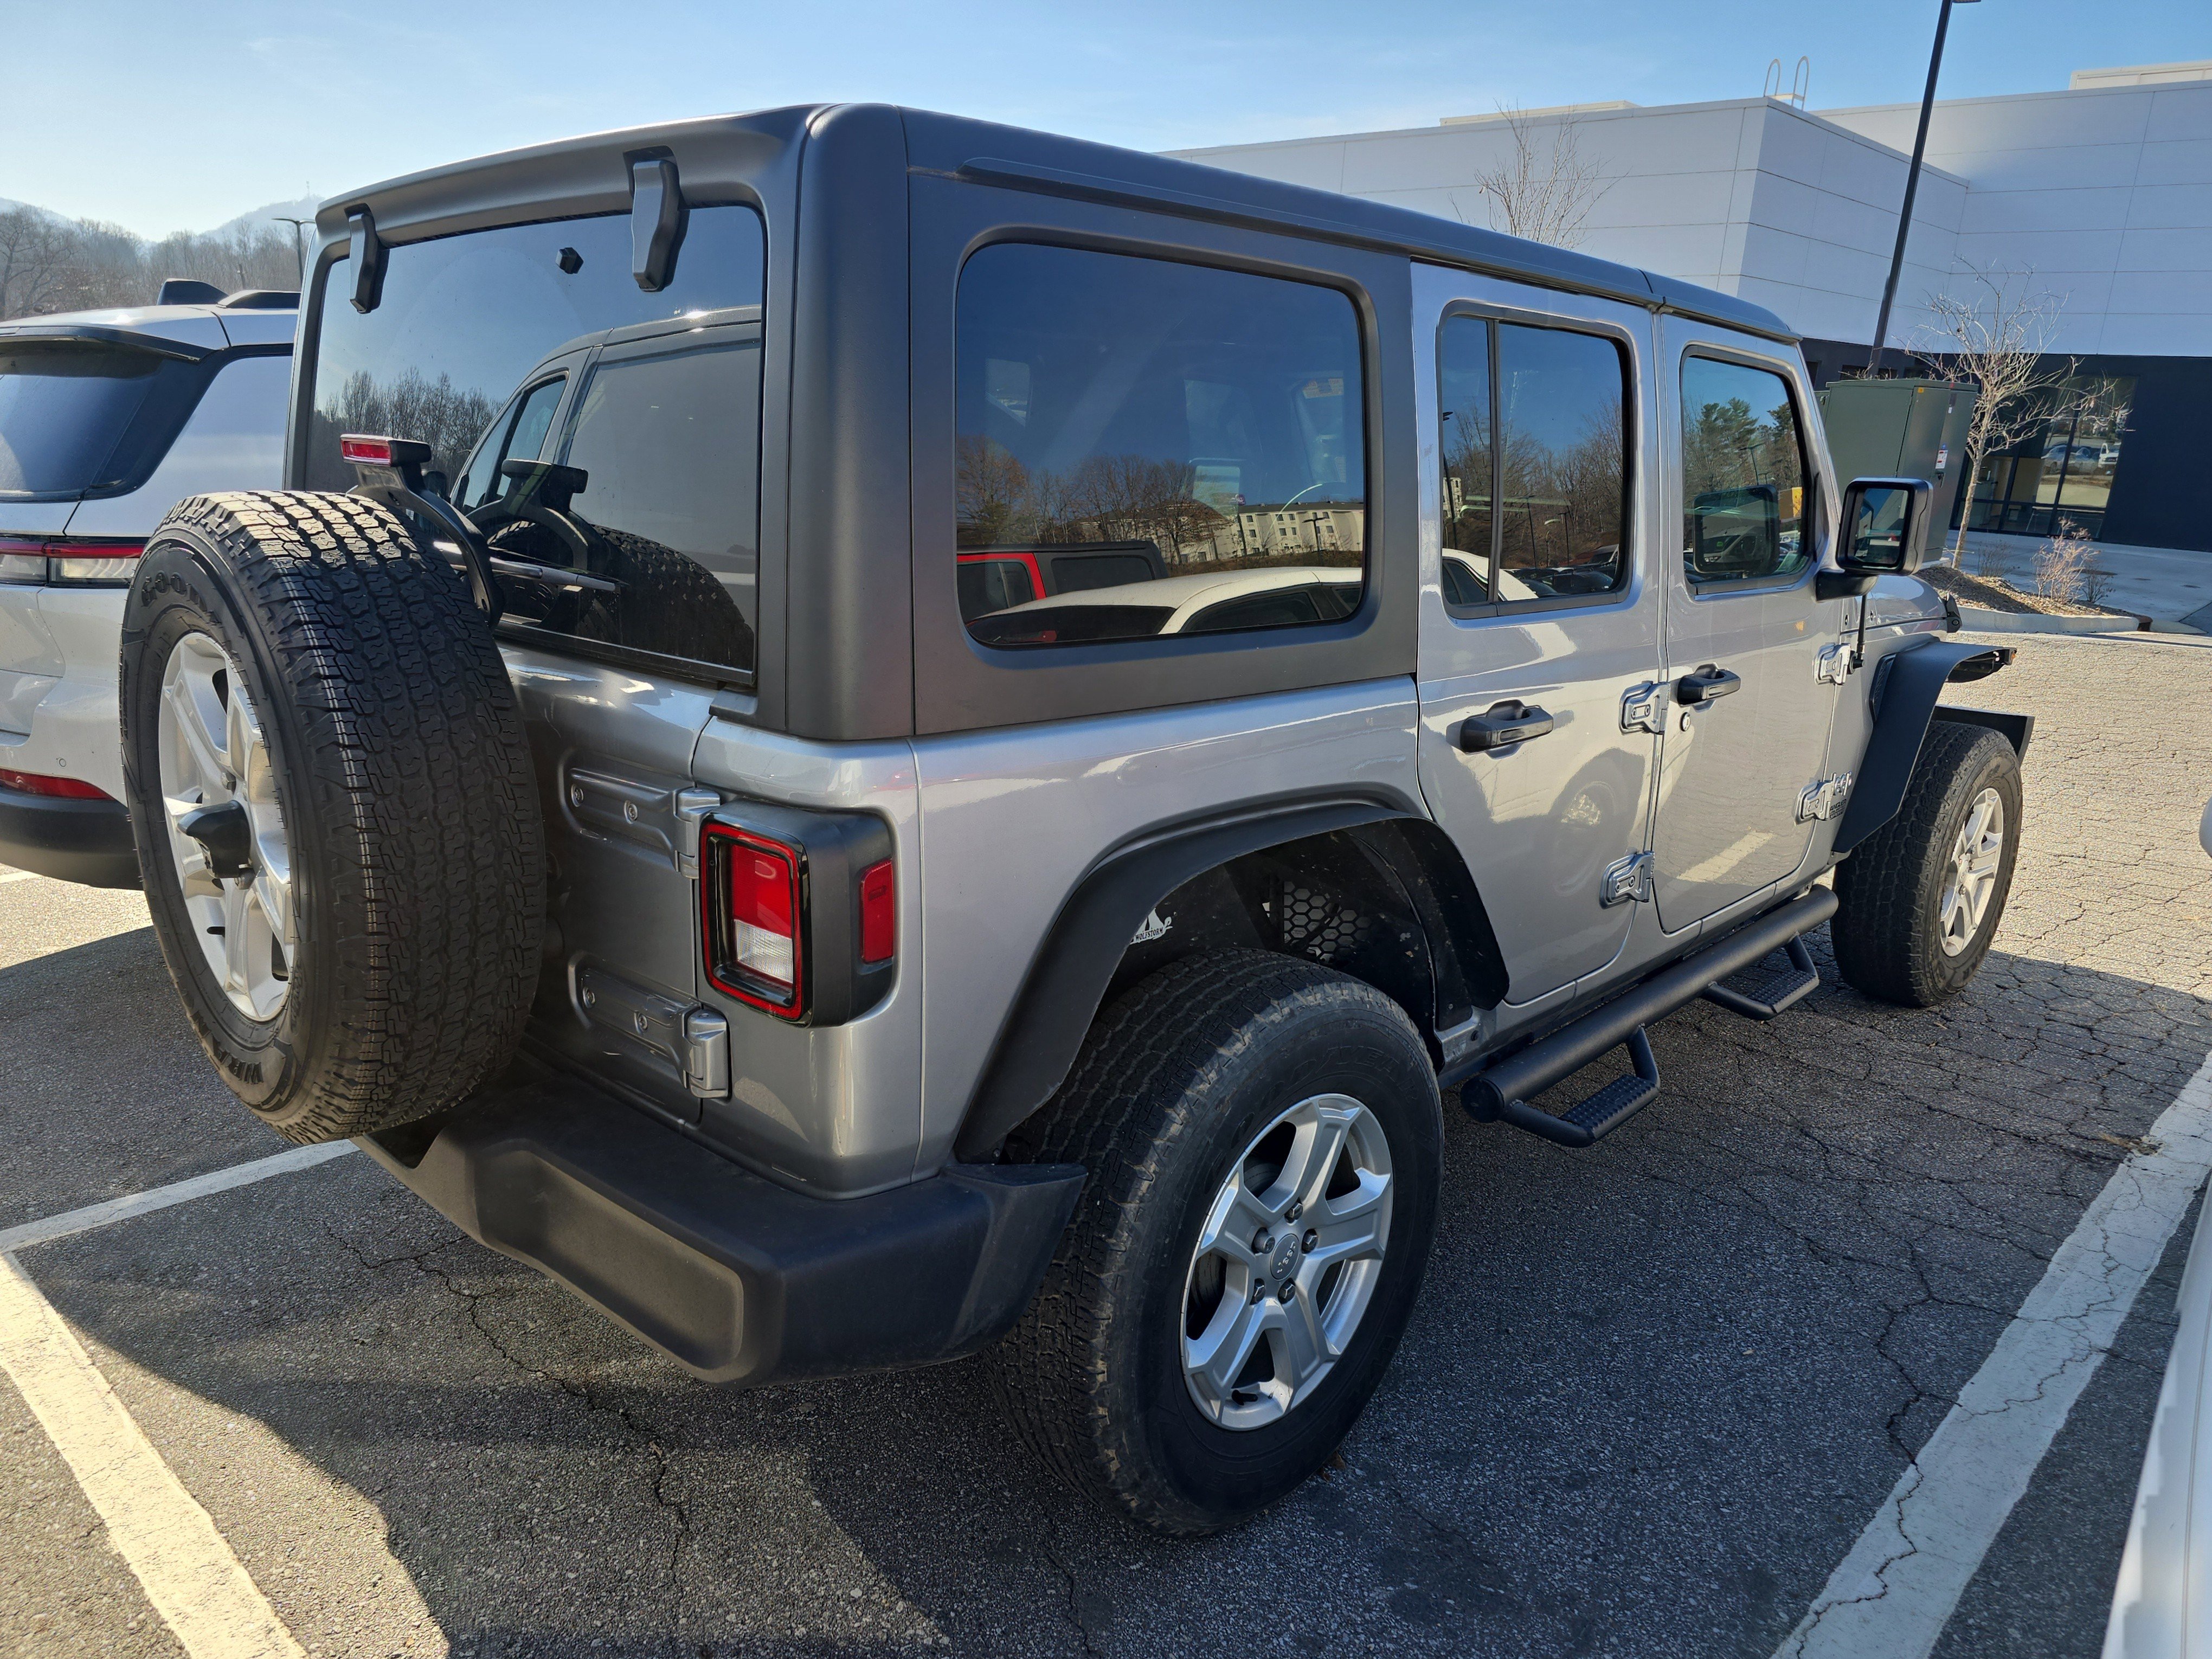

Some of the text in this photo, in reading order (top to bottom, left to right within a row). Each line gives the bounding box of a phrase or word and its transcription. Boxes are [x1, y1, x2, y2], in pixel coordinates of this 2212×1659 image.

[1830, 798, 1847, 811] ANGLER
[1135, 927, 1163, 941] WOLFSTORM
[1277, 1241, 1296, 1274] Jeep
